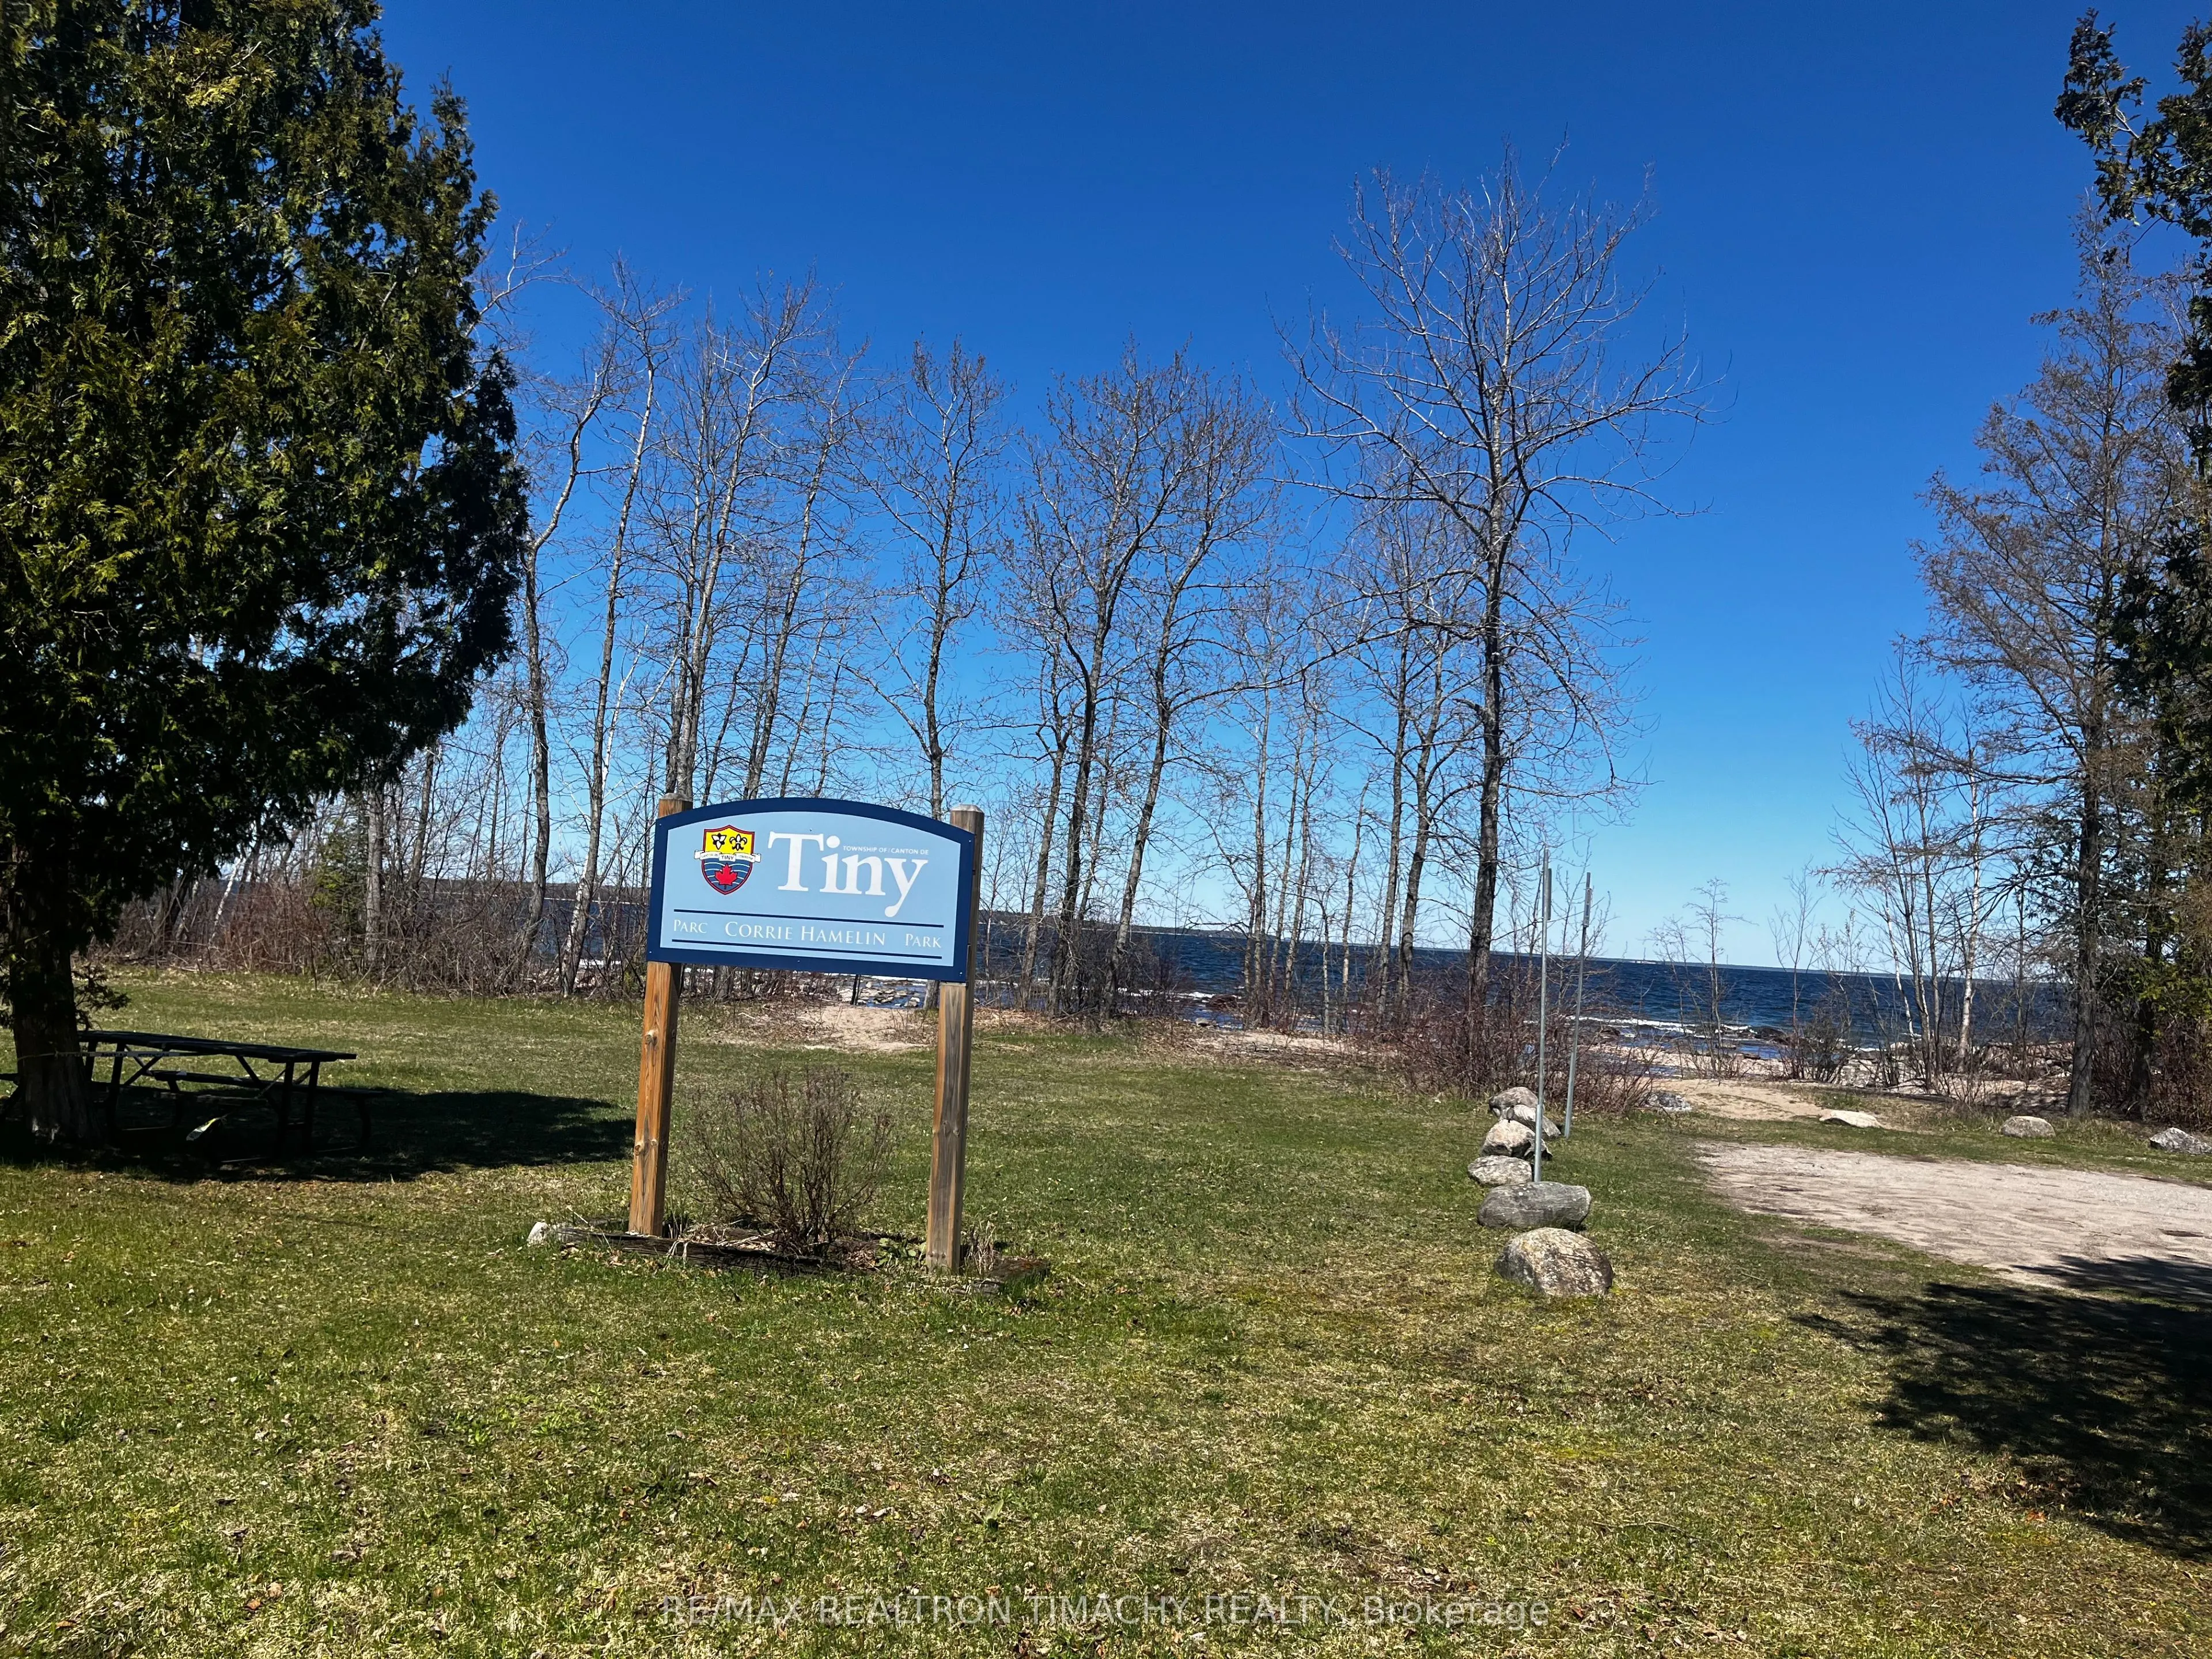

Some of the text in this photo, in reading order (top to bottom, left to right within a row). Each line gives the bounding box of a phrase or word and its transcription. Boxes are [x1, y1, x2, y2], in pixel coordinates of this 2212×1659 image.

[768, 831, 928, 917] Tiny
[673, 919, 942, 948] PARC CORRIE HAMELIN PARK
